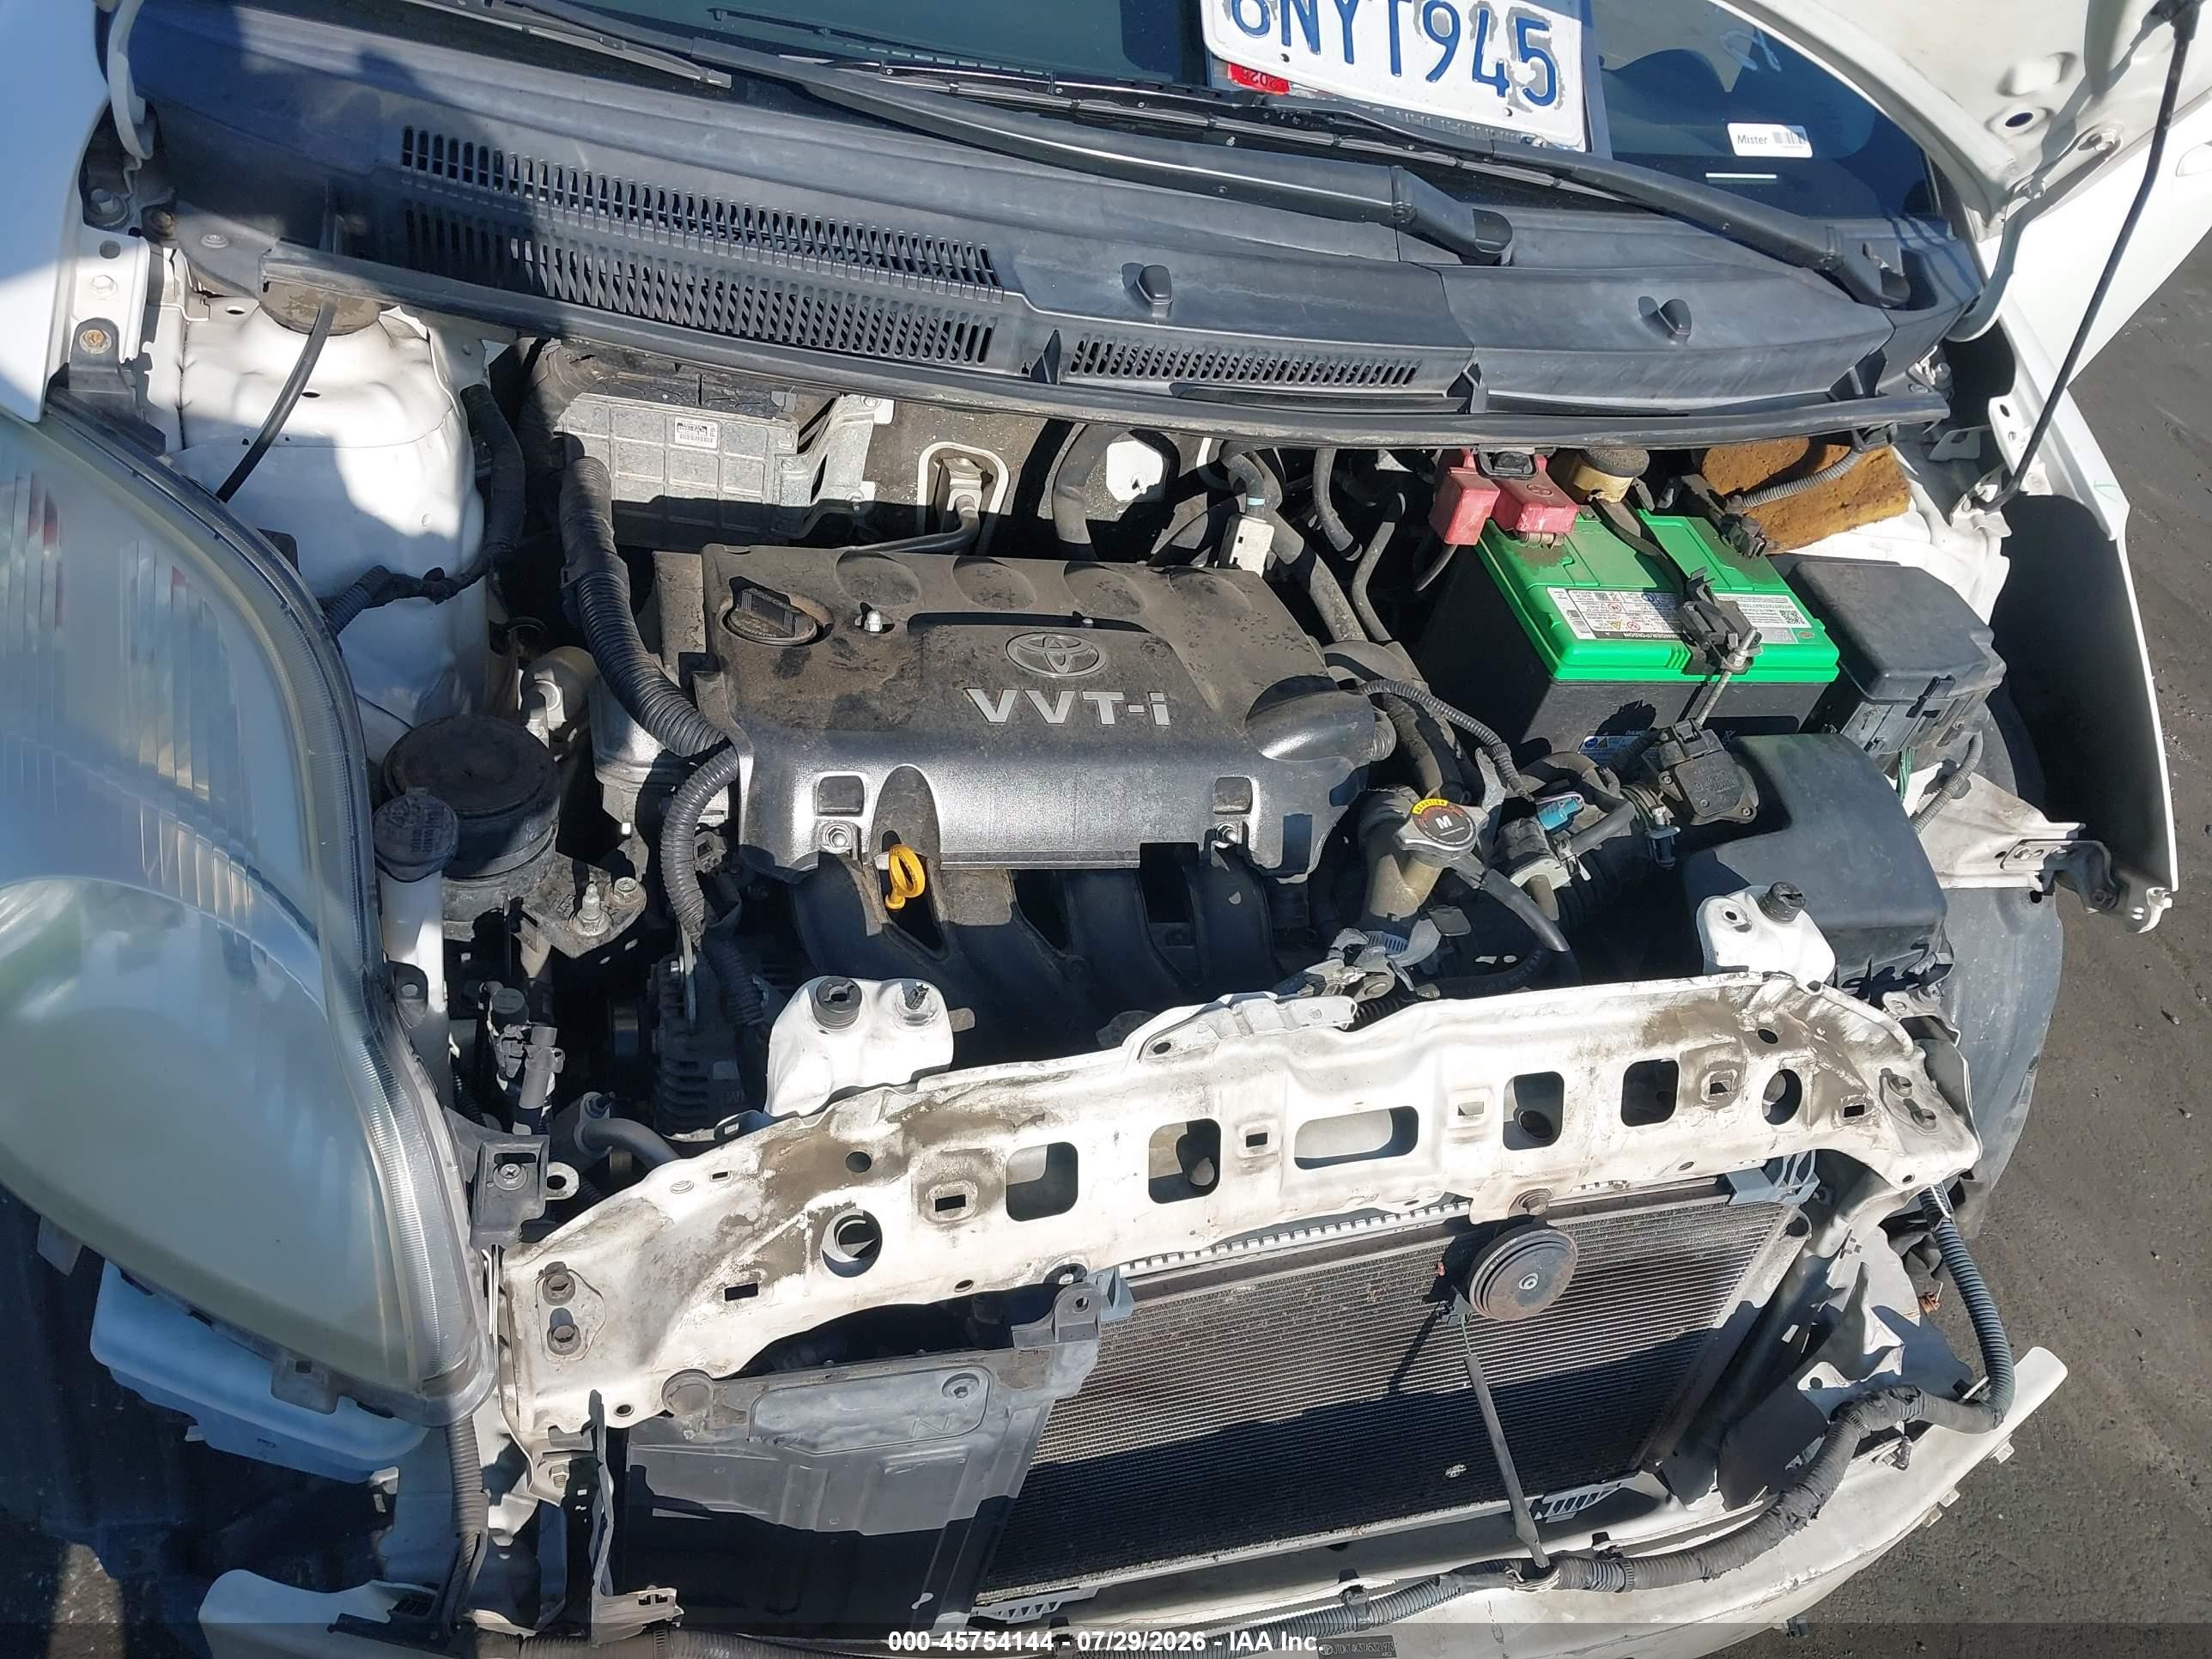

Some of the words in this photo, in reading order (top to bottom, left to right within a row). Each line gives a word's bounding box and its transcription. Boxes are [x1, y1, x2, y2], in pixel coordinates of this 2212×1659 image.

[1737, 134, 1768, 145] Mister
[964, 688, 1170, 726] VVT-i
[1418, 799, 1445, 810] CAUTION
